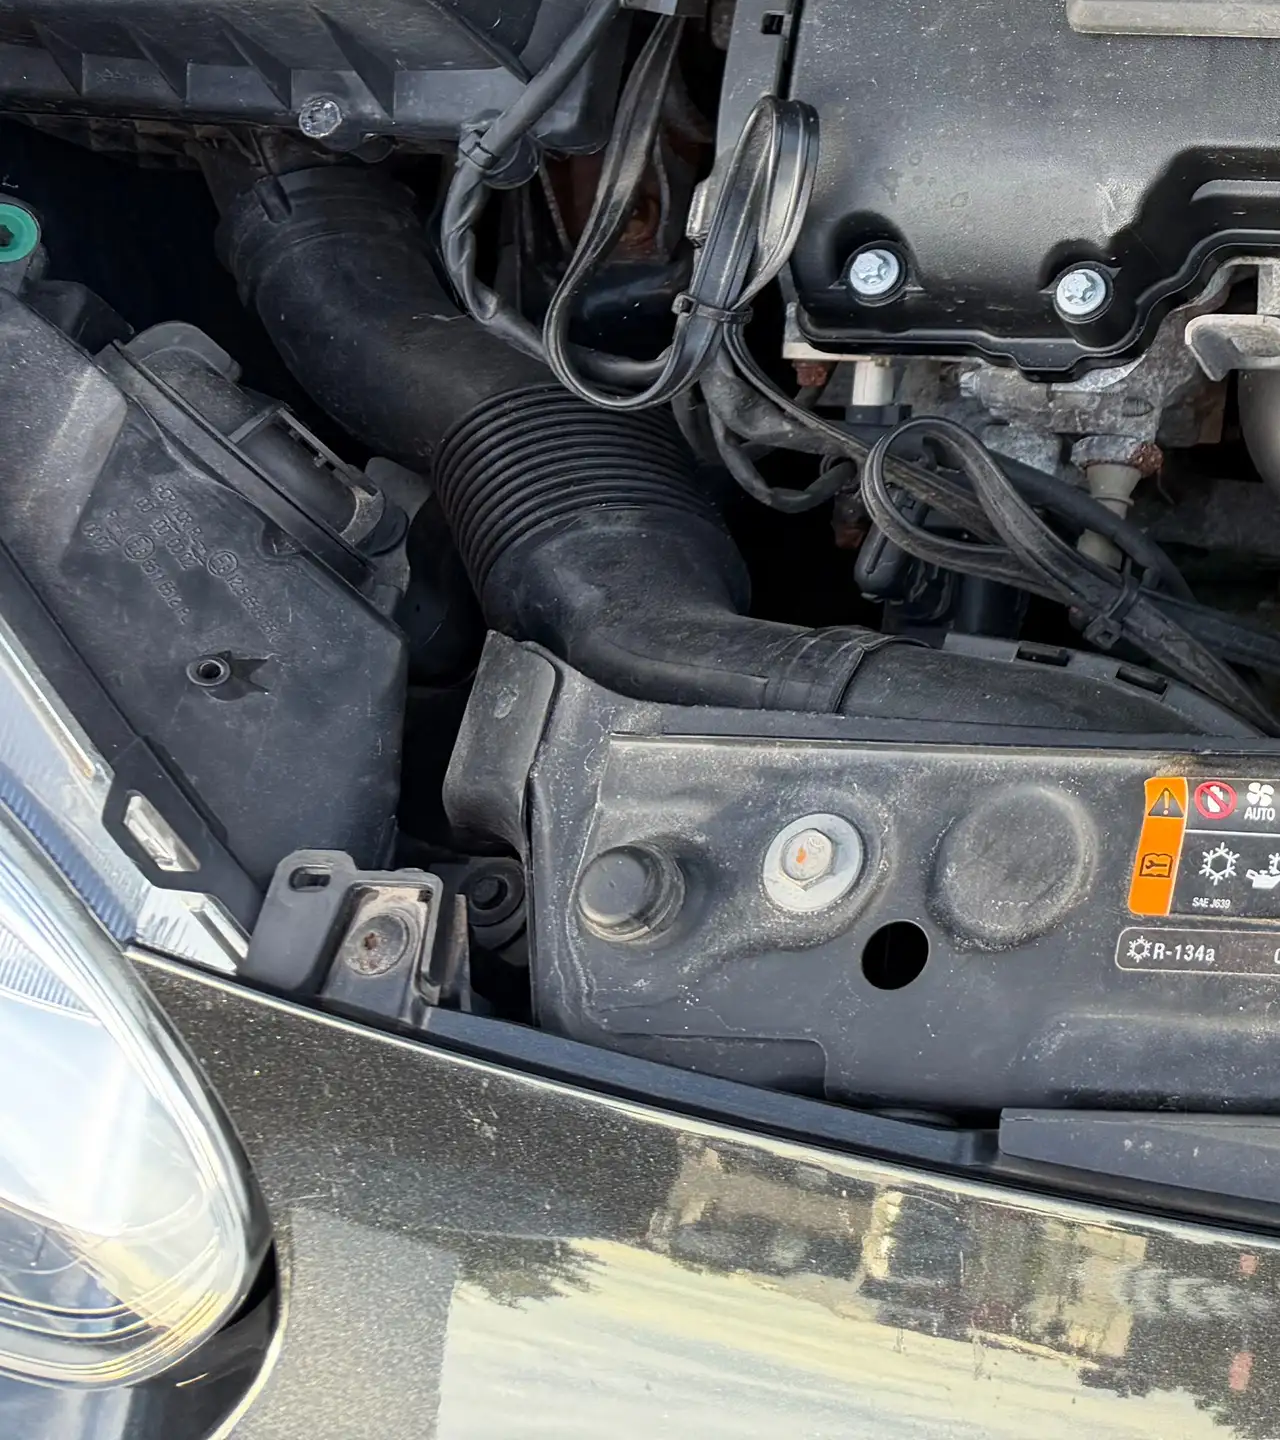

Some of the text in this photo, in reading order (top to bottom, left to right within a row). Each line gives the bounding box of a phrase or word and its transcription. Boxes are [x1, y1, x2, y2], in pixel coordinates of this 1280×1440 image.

[1244, 806, 1275, 821] AUTO
[1192, 897, 1231, 910] SAE J639
[1153, 943, 1216, 962] R-134a
